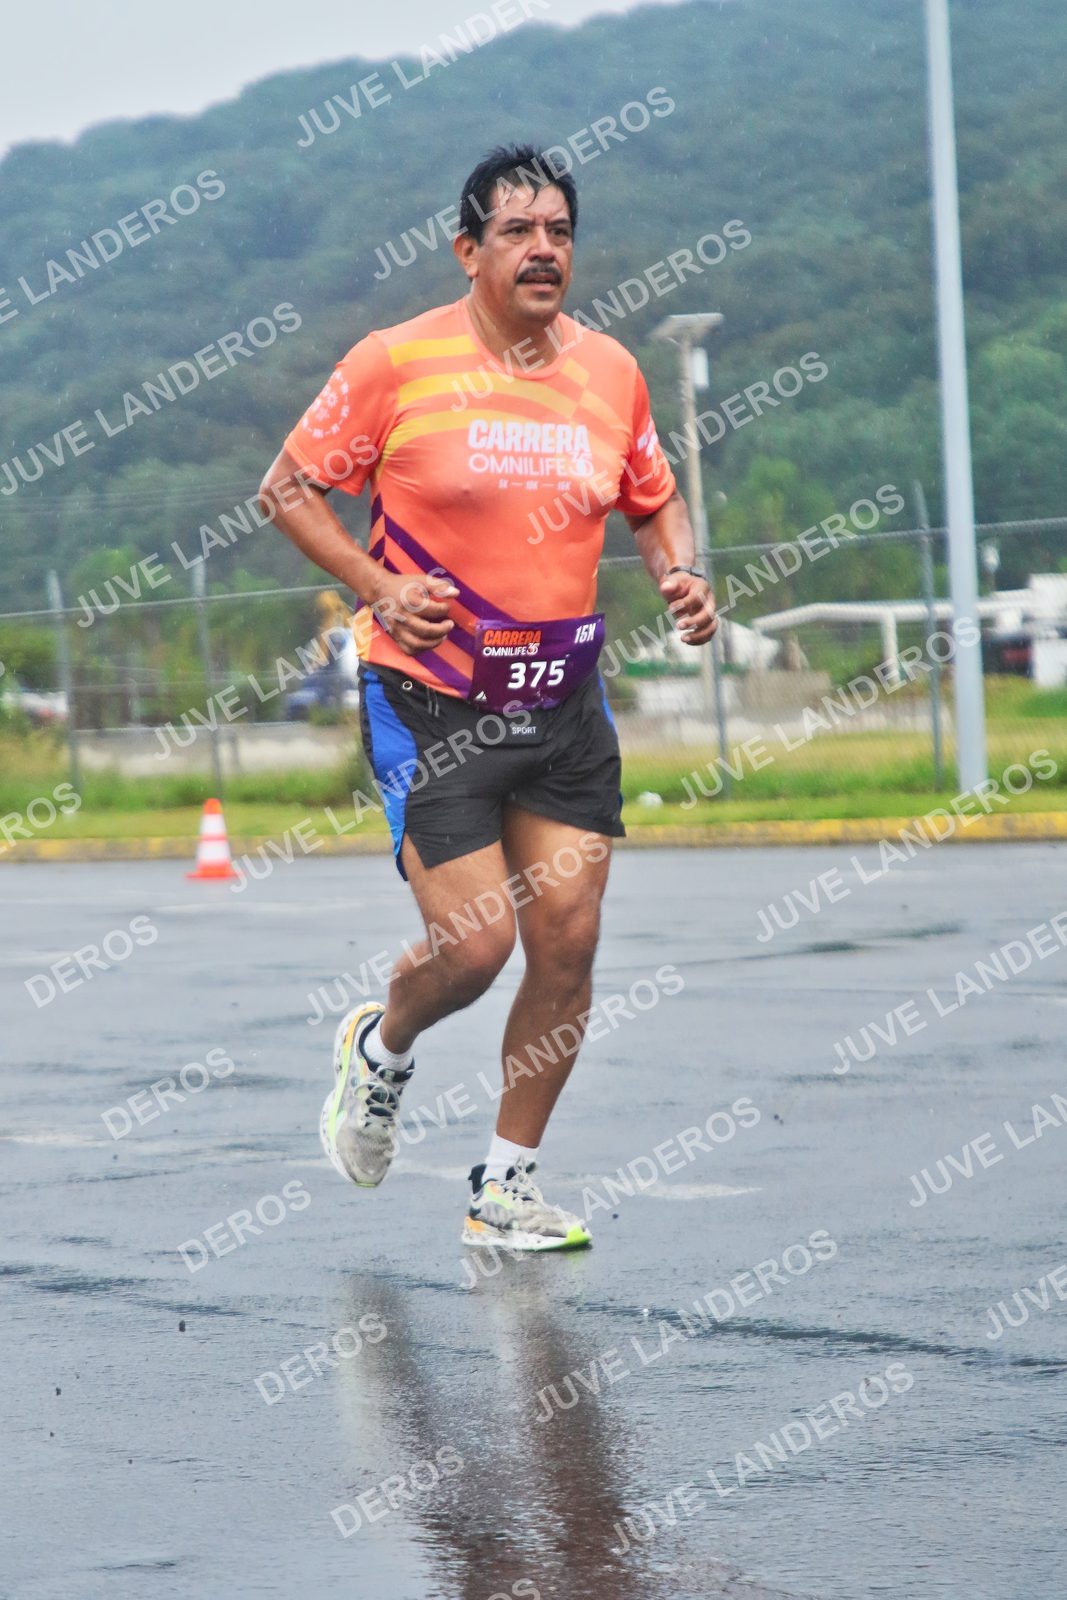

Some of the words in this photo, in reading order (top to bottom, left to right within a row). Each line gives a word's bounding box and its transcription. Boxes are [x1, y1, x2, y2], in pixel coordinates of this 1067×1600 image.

[468, 419, 591, 453] CARRERA
[468, 453, 568, 477] OMNILIFE
[483, 629, 541, 646] CARRERA
[483, 646, 526, 657] OMNILIFE
[507, 659, 566, 689] 375
[511, 726, 537, 735] SPORT
